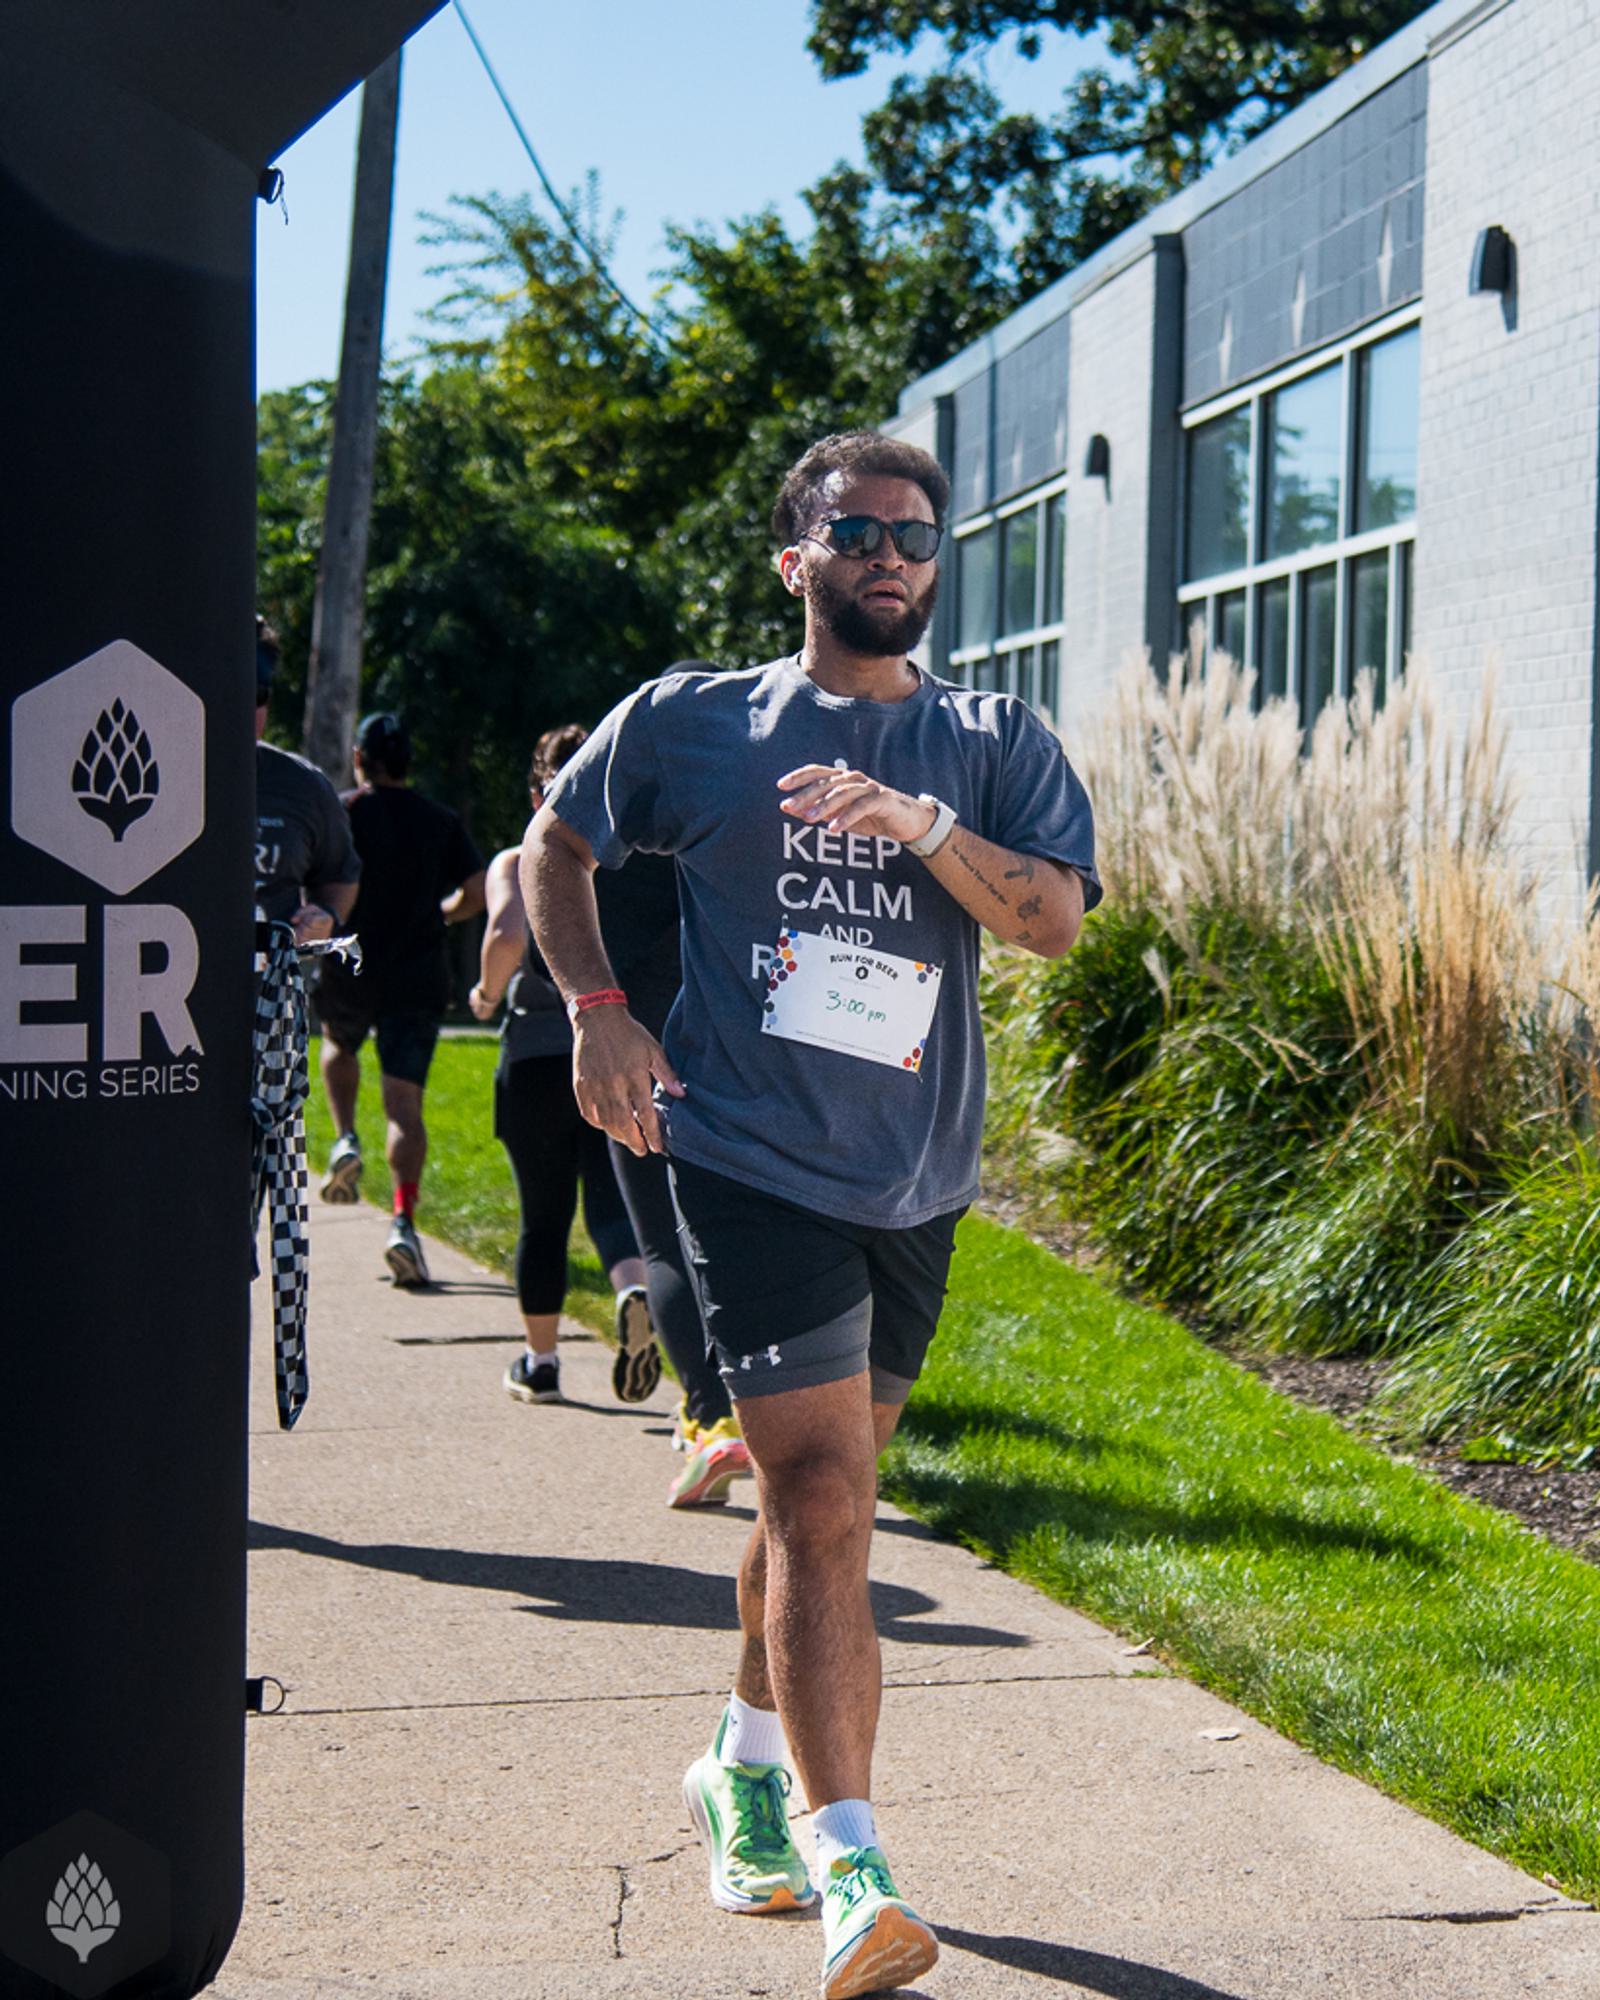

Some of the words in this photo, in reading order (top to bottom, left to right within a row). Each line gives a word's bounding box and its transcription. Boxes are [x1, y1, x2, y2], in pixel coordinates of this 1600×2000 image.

[783, 822, 902, 870] KEEP
[776, 872, 913, 921] CALM
[820, 923, 874, 947] AND
[0, 904, 204, 1063] ER
[829, 954, 853, 964] RUN
[855, 955, 875, 967] FOR
[875, 961, 899, 981] BEER
[826, 990, 866, 1015] 3:00
[100, 1063, 200, 1097] SERIES
